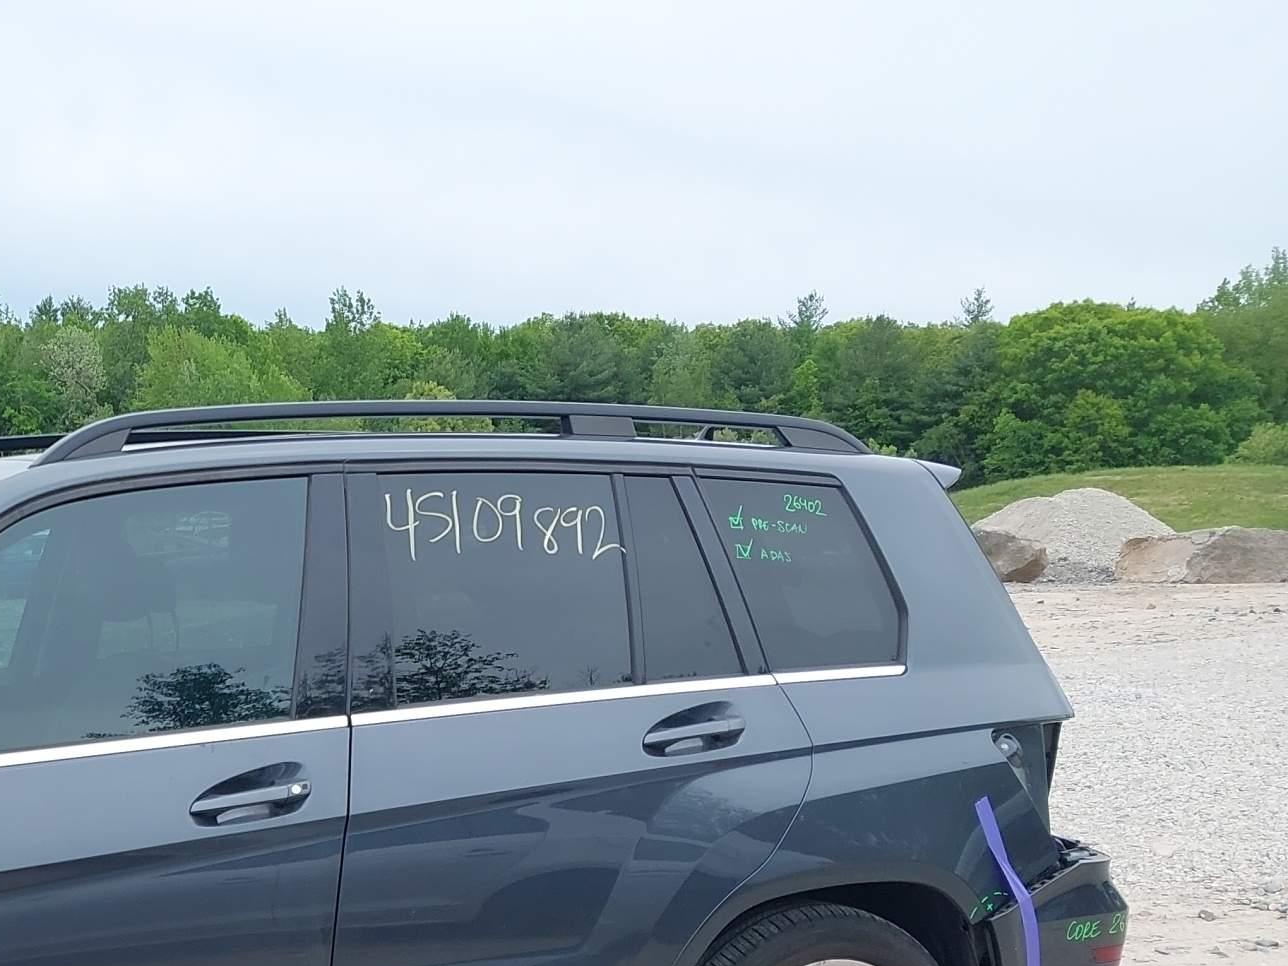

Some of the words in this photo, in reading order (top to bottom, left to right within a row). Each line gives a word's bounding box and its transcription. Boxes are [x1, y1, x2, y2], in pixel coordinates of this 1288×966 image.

[783, 494, 828, 517] 26402
[384, 488, 627, 561] 45109892
[760, 548, 792, 562] ADAS
[1066, 920, 1102, 941] CORE
